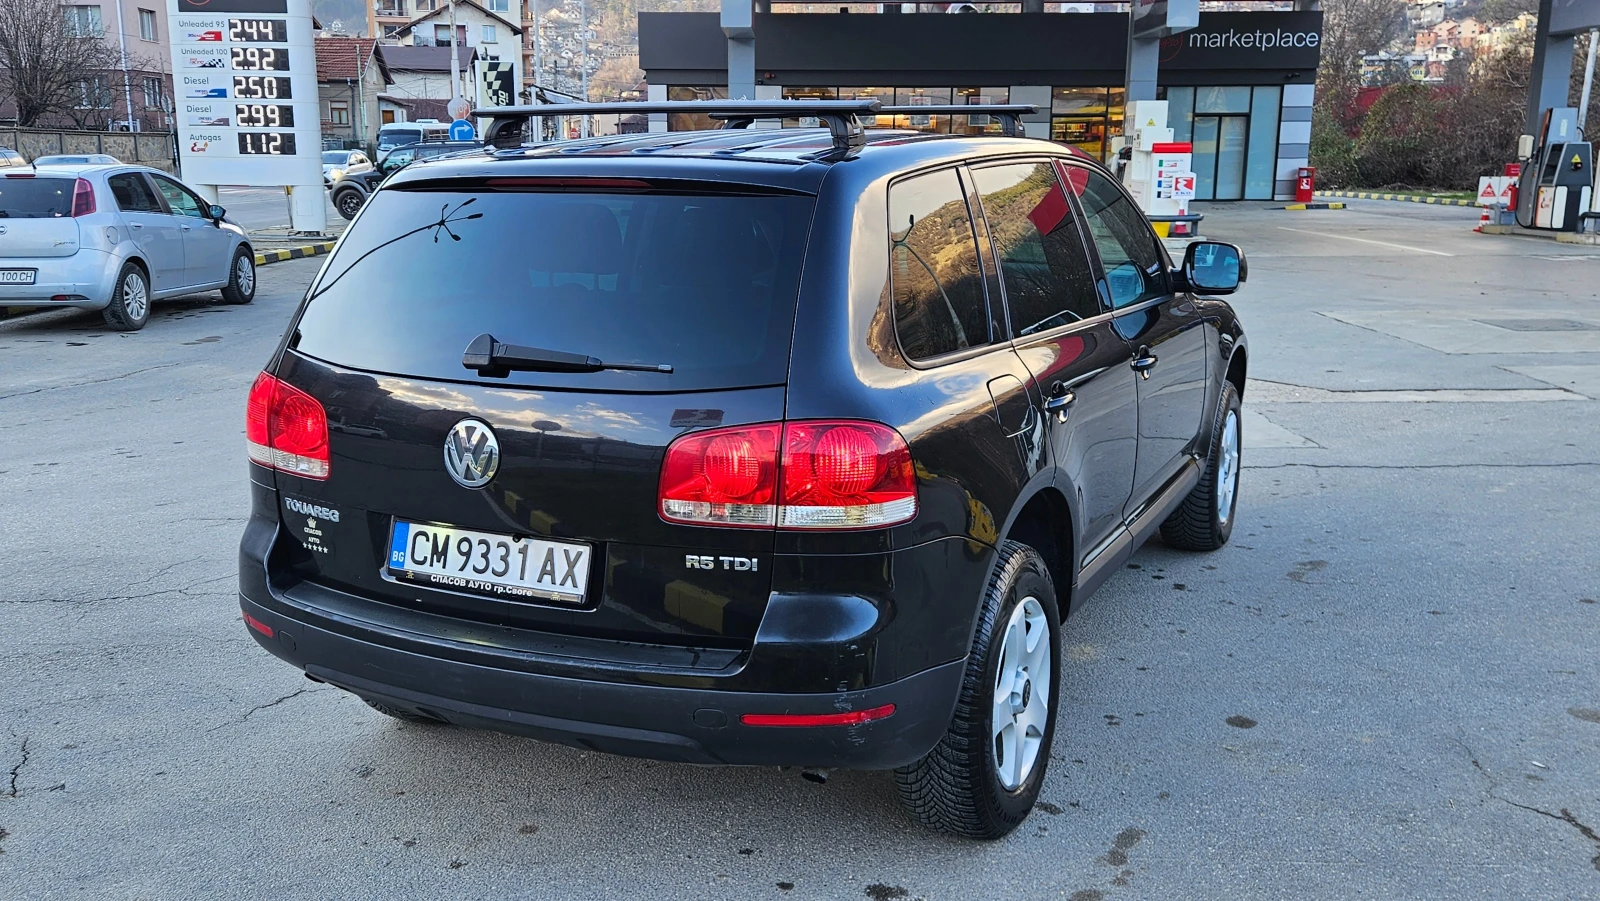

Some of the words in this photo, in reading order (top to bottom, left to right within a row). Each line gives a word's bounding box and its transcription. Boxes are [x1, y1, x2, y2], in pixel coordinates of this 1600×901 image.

[230, 19, 272, 41] 2.44
[1189, 28, 1318, 51] marketplace
[232, 48, 274, 70] 2.92
[184, 76, 209, 84] Diesel
[234, 76, 278, 98] 2.50
[236, 104, 280, 126] 2.99
[190, 134, 222, 142] Autogas
[246, 133, 281, 154] 1.12
[20, 272, 33, 281] CH
[284, 496, 340, 522] TOUAREG
[392, 550, 404, 562] BG
[410, 530, 450, 570] CM
[456, 536, 529, 581] 9331
[536, 548, 583, 588] AX
[685, 554, 714, 570] R5
[718, 556, 758, 572] TDI
[430, 574, 466, 587] СПАСОВ
[468, 581, 492, 591] АУТО
